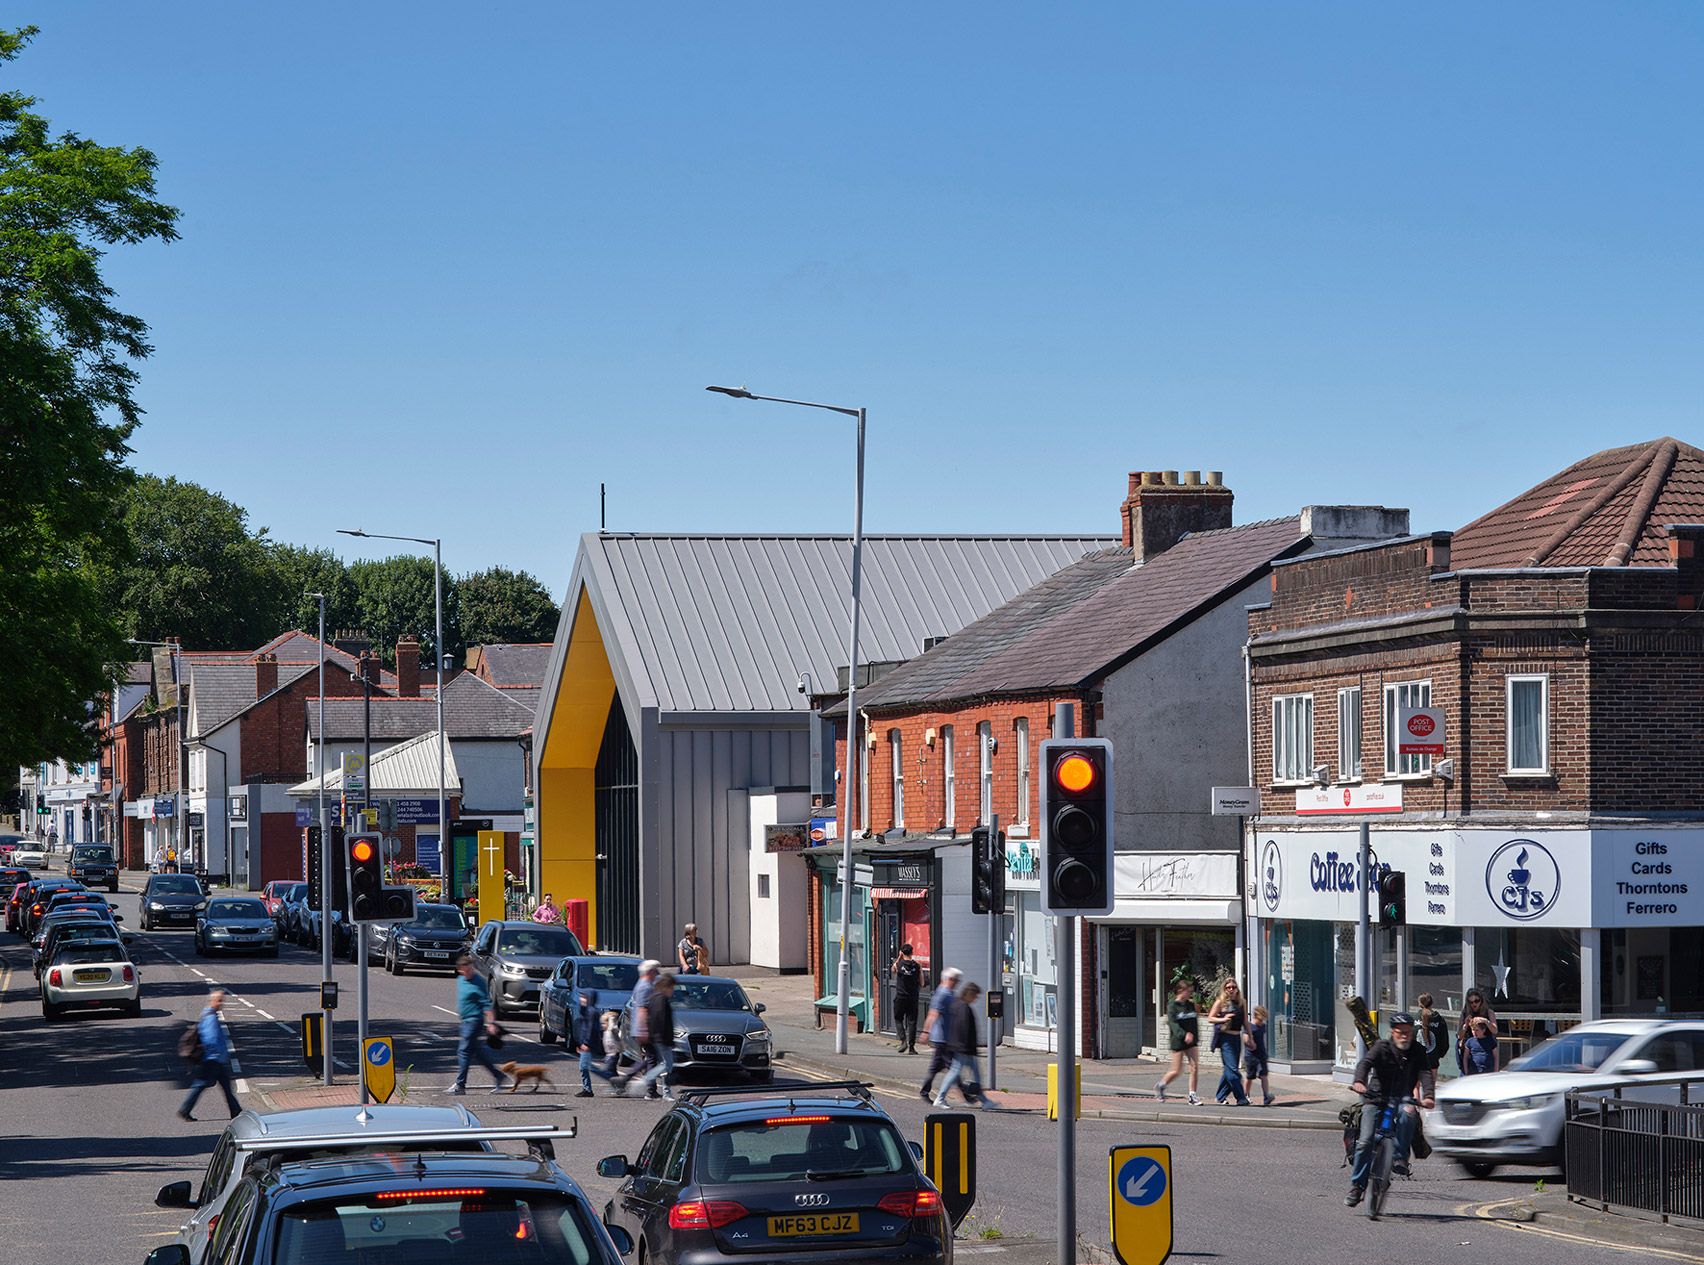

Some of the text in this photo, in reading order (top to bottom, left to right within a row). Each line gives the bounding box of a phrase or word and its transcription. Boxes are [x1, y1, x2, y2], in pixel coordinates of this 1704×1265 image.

[1409, 724, 1432, 732] OFFICE
[1430, 843, 1443, 857] Gifts
[1635, 842, 1668, 855] Gifts
[1310, 851, 1355, 893] Coffee
[1429, 862, 1445, 877] Cards
[1631, 861, 1672, 875] Cards
[1424, 881, 1450, 896] Thorntons
[1616, 882, 1688, 895] Thorntons
[1427, 900, 1446, 915] Ferrero
[1626, 901, 1678, 914] Ferrero
[701, 1045, 732, 1053] SA16 ZON
[774, 1215, 852, 1234] MF63 CJZ
[732, 1231, 749, 1239] A4
